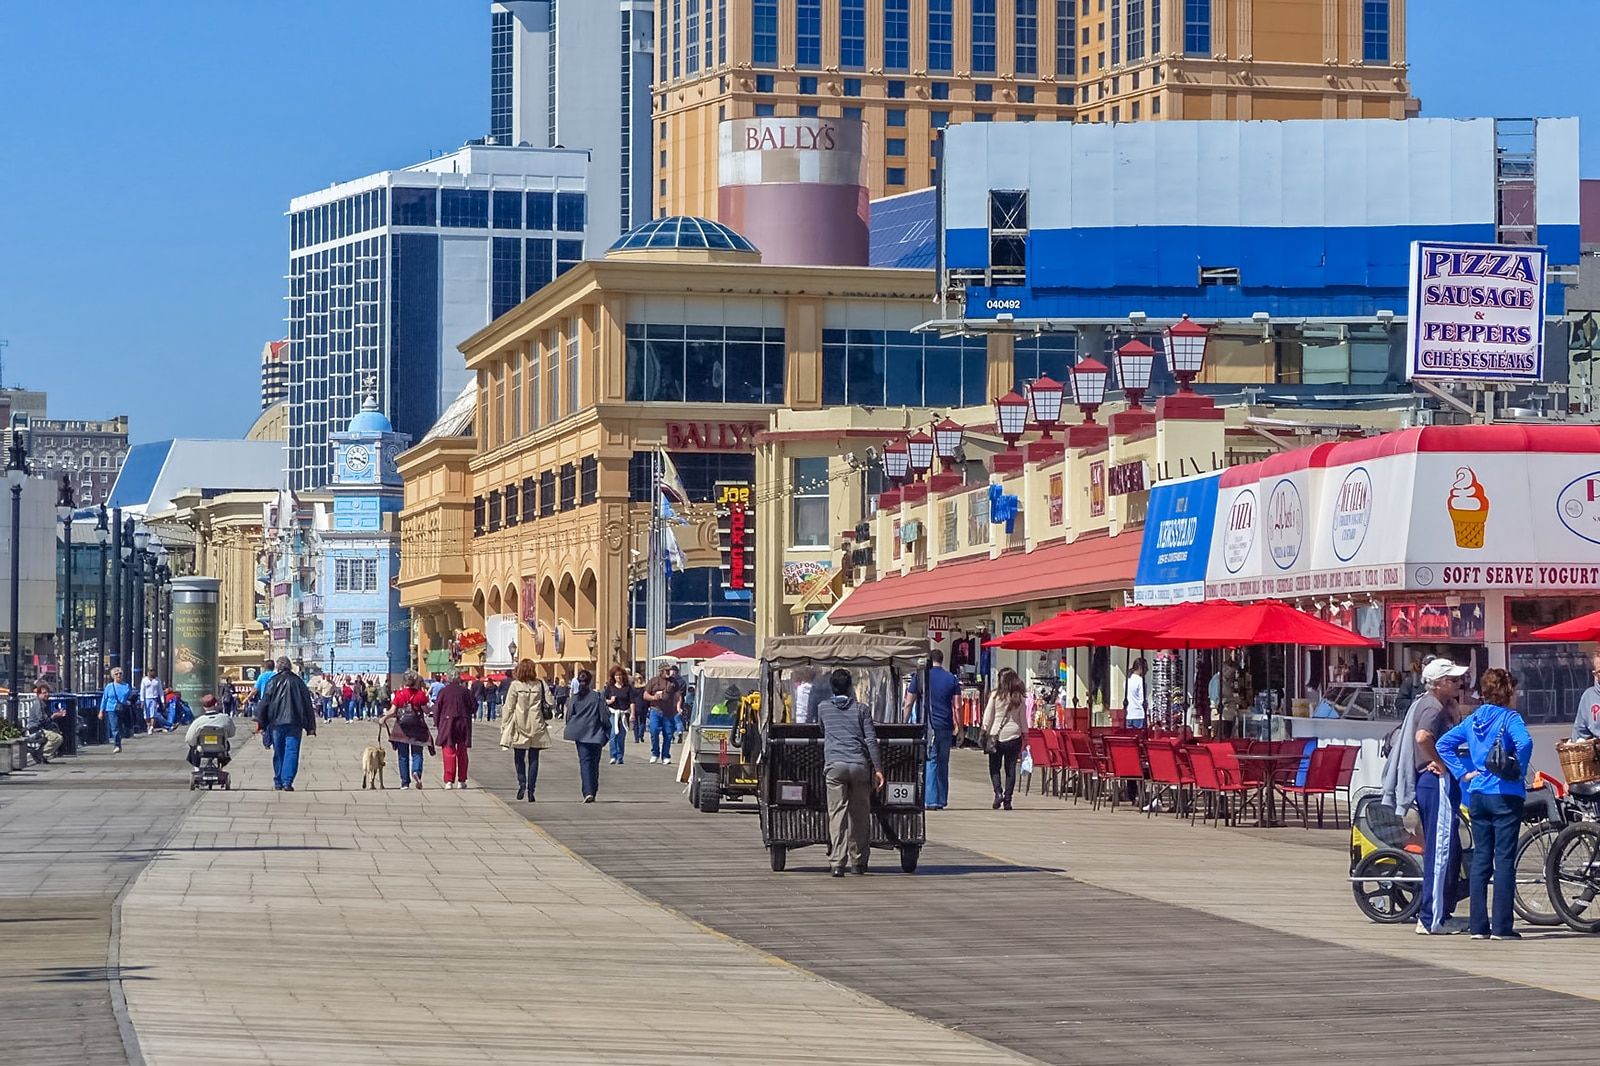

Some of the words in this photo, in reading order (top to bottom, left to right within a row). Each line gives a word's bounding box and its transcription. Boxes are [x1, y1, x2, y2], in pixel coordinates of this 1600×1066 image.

[746, 124, 835, 151] BALLY'S
[1424, 250, 1538, 286] PIZZA
[986, 299, 1021, 309] 040492
[1424, 283, 1535, 310] SAUSAGE
[1474, 311, 1485, 320] &
[1423, 321, 1532, 345] PEPPERS
[1421, 349, 1535, 372] CHEESESTEAKS
[1443, 567, 1481, 584] SOFT
[1486, 567, 1534, 584] SERVE
[1539, 567, 1600, 584] YOGURT
[929, 616, 949, 629] ATM
[1004, 615, 1023, 624] ATM
[893, 788, 909, 799] 39
